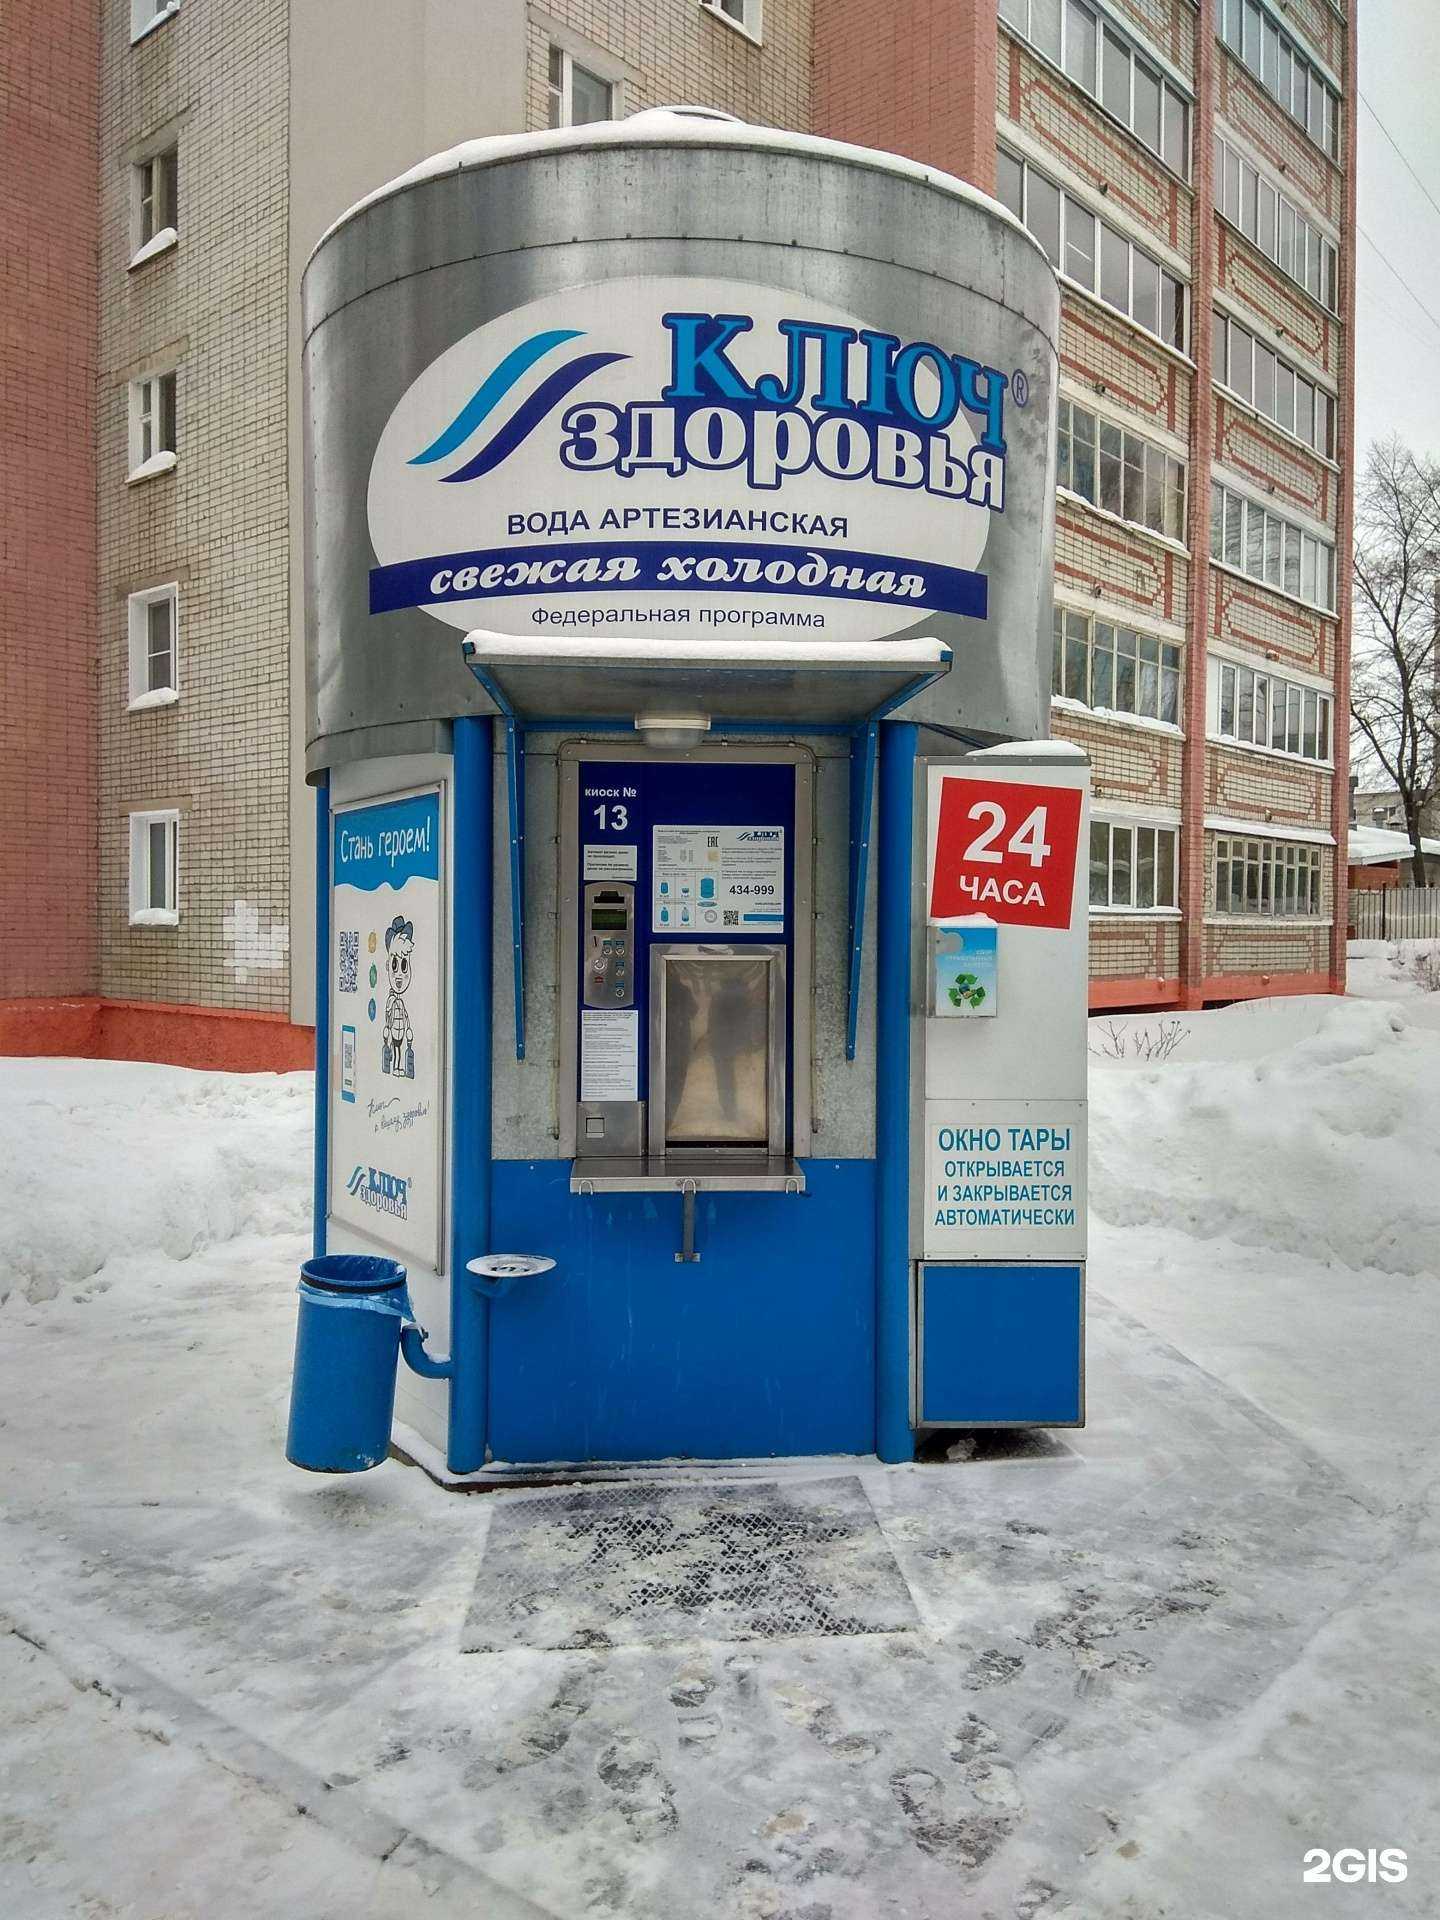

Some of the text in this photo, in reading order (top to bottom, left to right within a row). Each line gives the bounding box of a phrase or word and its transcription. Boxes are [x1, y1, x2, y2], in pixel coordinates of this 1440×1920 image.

[661, 312, 1009, 451] КЛЮЧ
[560, 402, 1006, 513] здоровья
[507, 507, 849, 538] ВОДА АРТЕЗИАНСКАЯ
[429, 551, 927, 599] свежая холодная
[531, 607, 826, 629] Федеральная программа
[584, 788, 620, 798] киоск
[593, 804, 629, 831] 13
[340, 815, 431, 868] Стань героем!
[962, 801, 1052, 868] 24
[729, 885, 775, 895] 434-999
[959, 874, 1046, 907] ЧАСА
[938, 1128, 1071, 1151] ОКНО ТАРЫ
[944, 1160, 1065, 1177] ОТКРЫВАЕТСЯ
[937, 1184, 1072, 1202] И ЗАКРЫВАЕТСЯ
[934, 1208, 1076, 1227] АВТОМАТИЧЕСКИ
